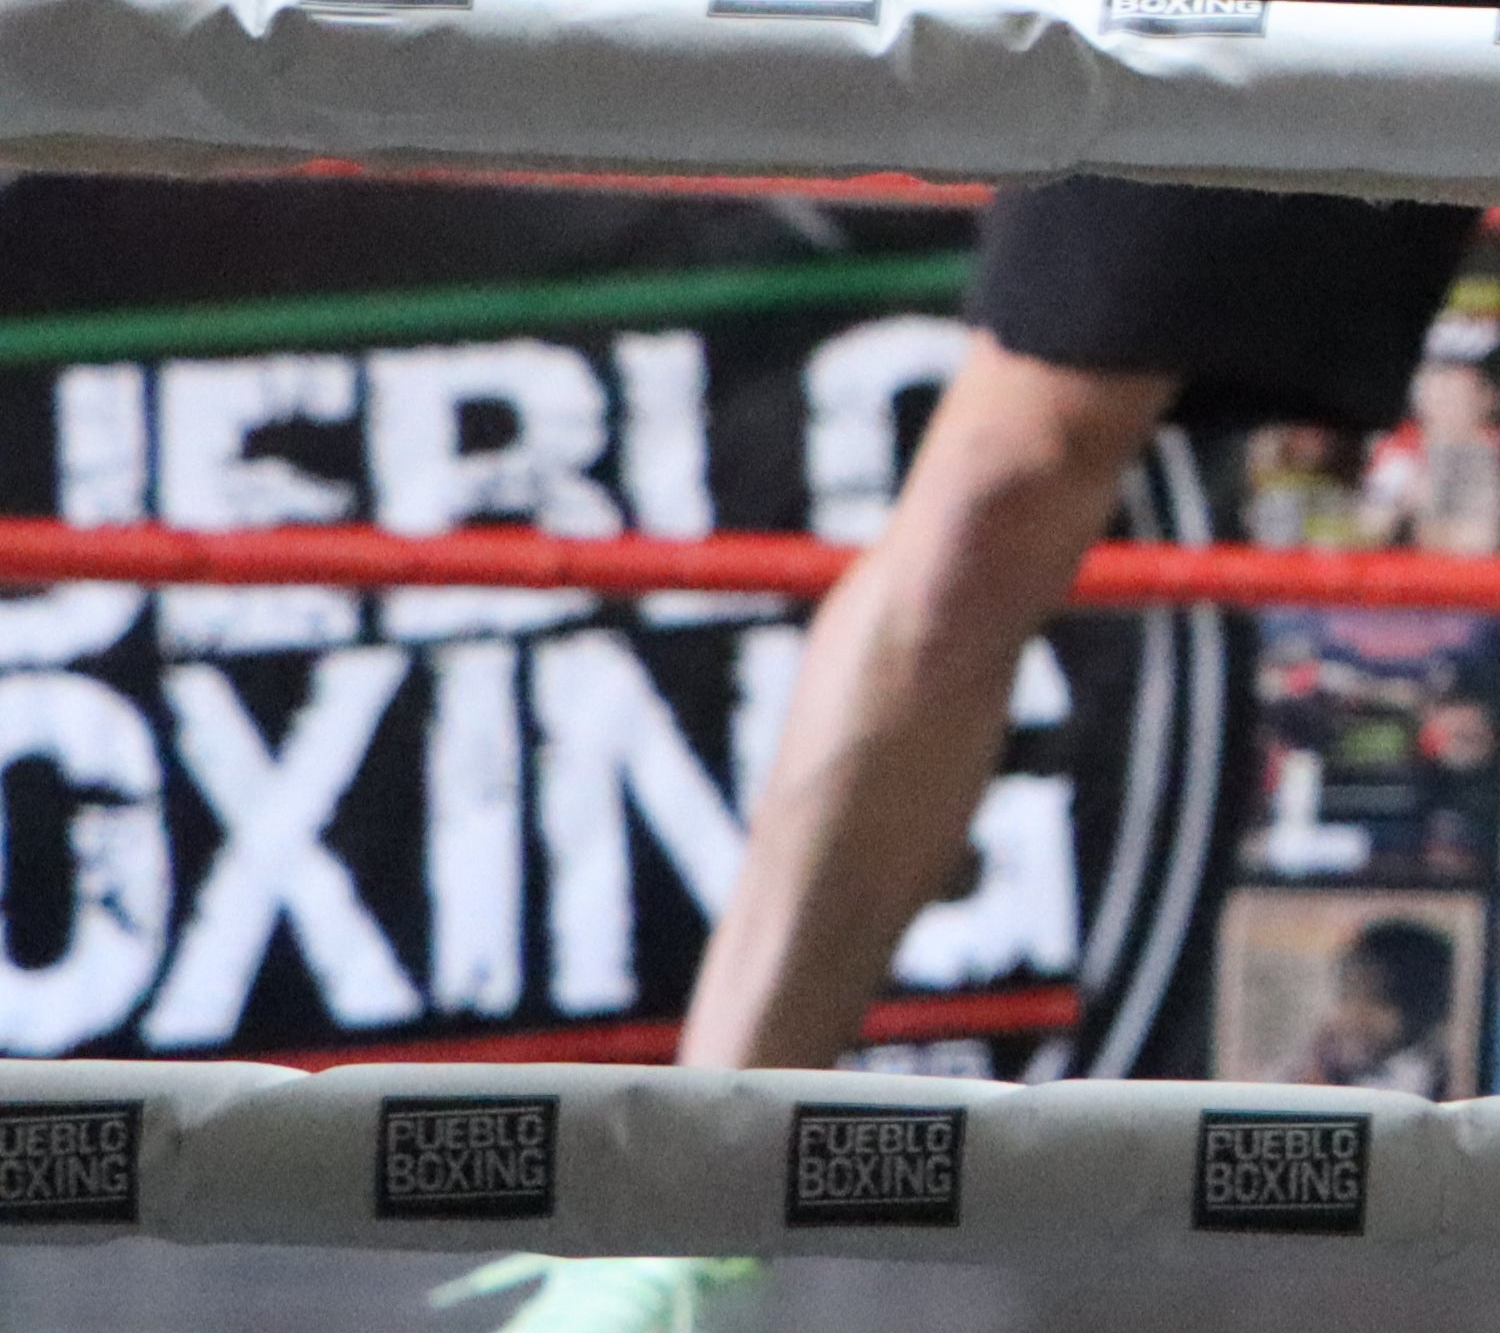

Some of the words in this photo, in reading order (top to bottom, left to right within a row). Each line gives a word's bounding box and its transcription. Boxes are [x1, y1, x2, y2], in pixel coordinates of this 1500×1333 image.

[0, 316, 982, 665] UEBLO
[0, 631, 1080, 1055] OXING
[0, 1120, 127, 1156] UEBLO
[388, 1112, 544, 1153] PUEBLO
[801, 1122, 953, 1155] PUEBLO
[1207, 1129, 1356, 1161] PUEBLO
[0, 1154, 128, 1197] OXING
[387, 1149, 546, 1193] BOXING
[800, 1155, 953, 1199] BOXING
[1206, 1160, 1359, 1203] BOXING
